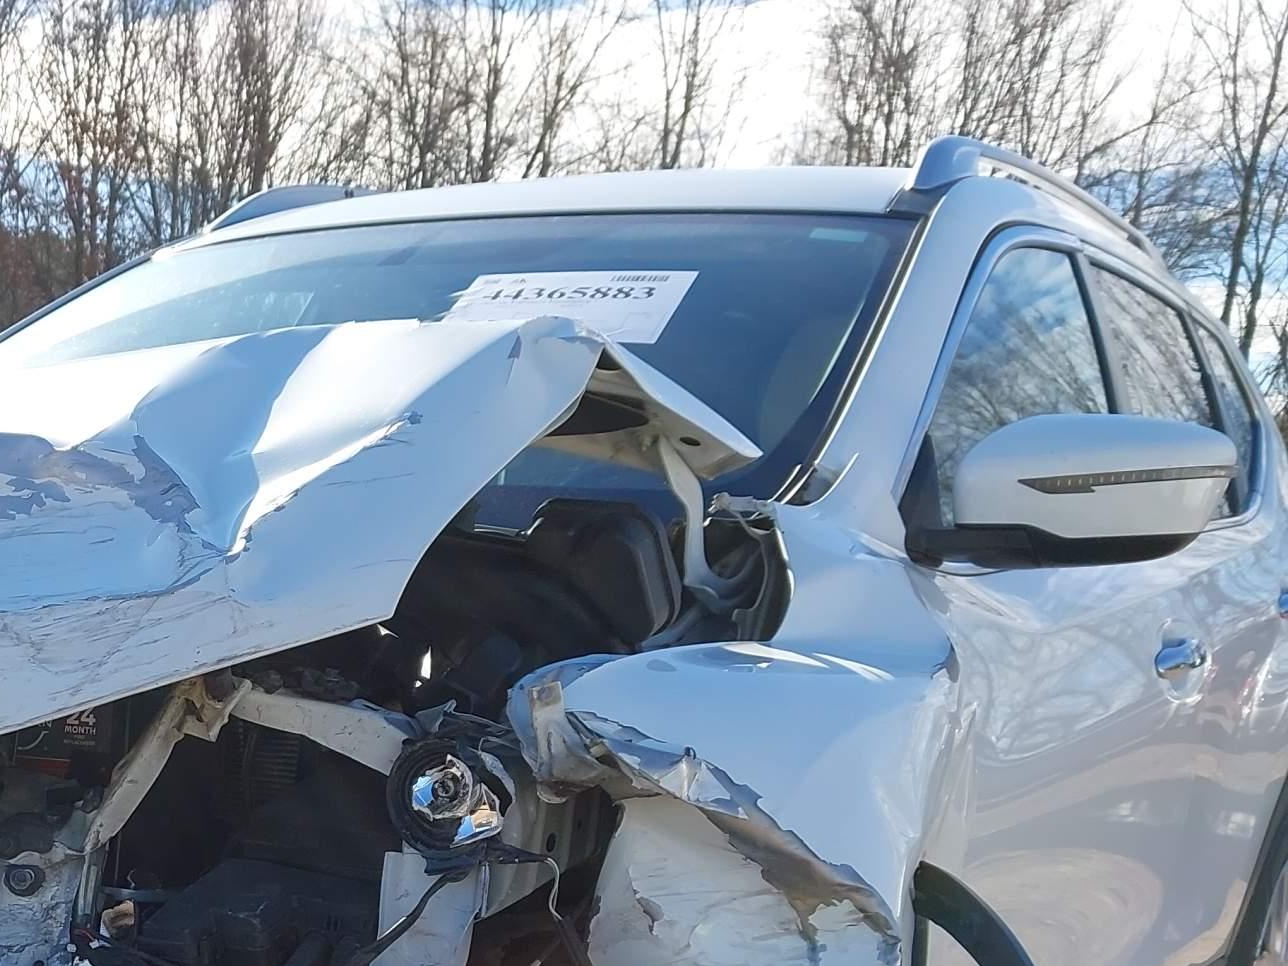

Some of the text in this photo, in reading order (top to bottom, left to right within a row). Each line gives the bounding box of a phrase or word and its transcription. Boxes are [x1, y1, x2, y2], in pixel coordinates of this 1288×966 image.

[483, 286, 657, 300] 44365883
[66, 707, 96, 726] 24
[64, 725, 97, 736] MONTH
